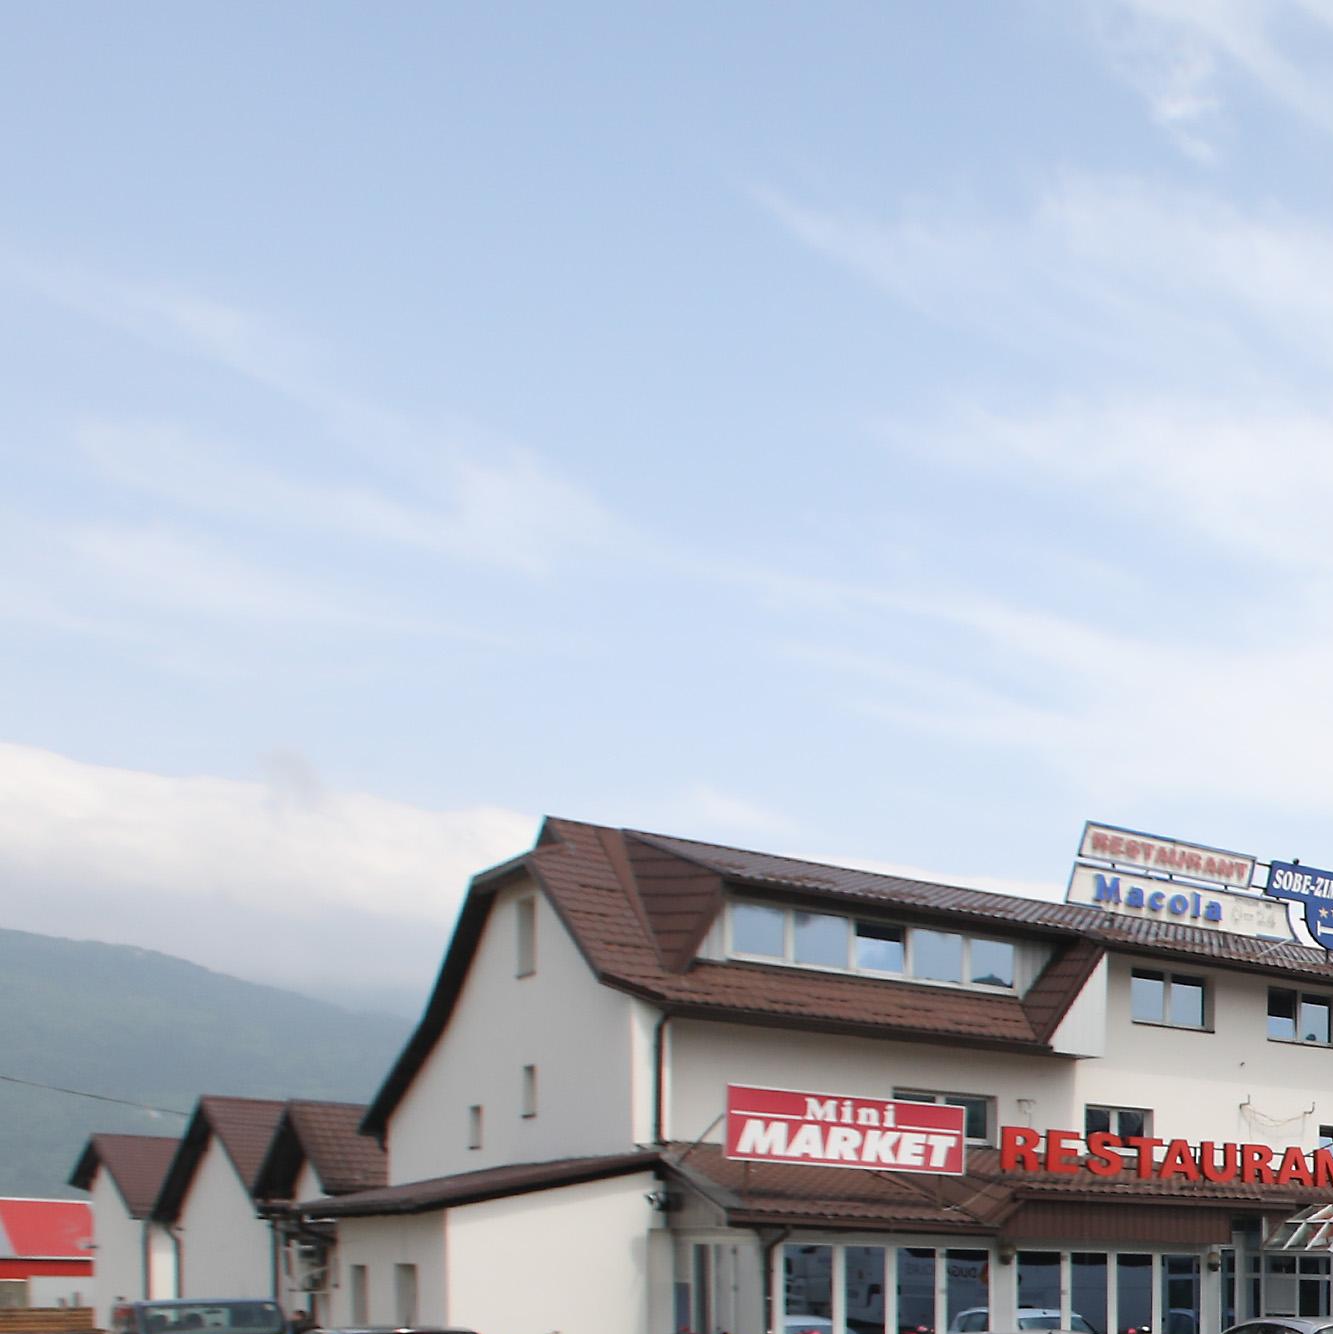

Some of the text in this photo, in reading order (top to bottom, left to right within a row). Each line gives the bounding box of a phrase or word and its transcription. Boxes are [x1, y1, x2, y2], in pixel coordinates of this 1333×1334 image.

[1091, 831, 1248, 880] RESTAURANT
[1092, 872, 1223, 921] Macola
[803, 1097, 897, 1129] Mini
[735, 1118, 958, 1169] MARKET
